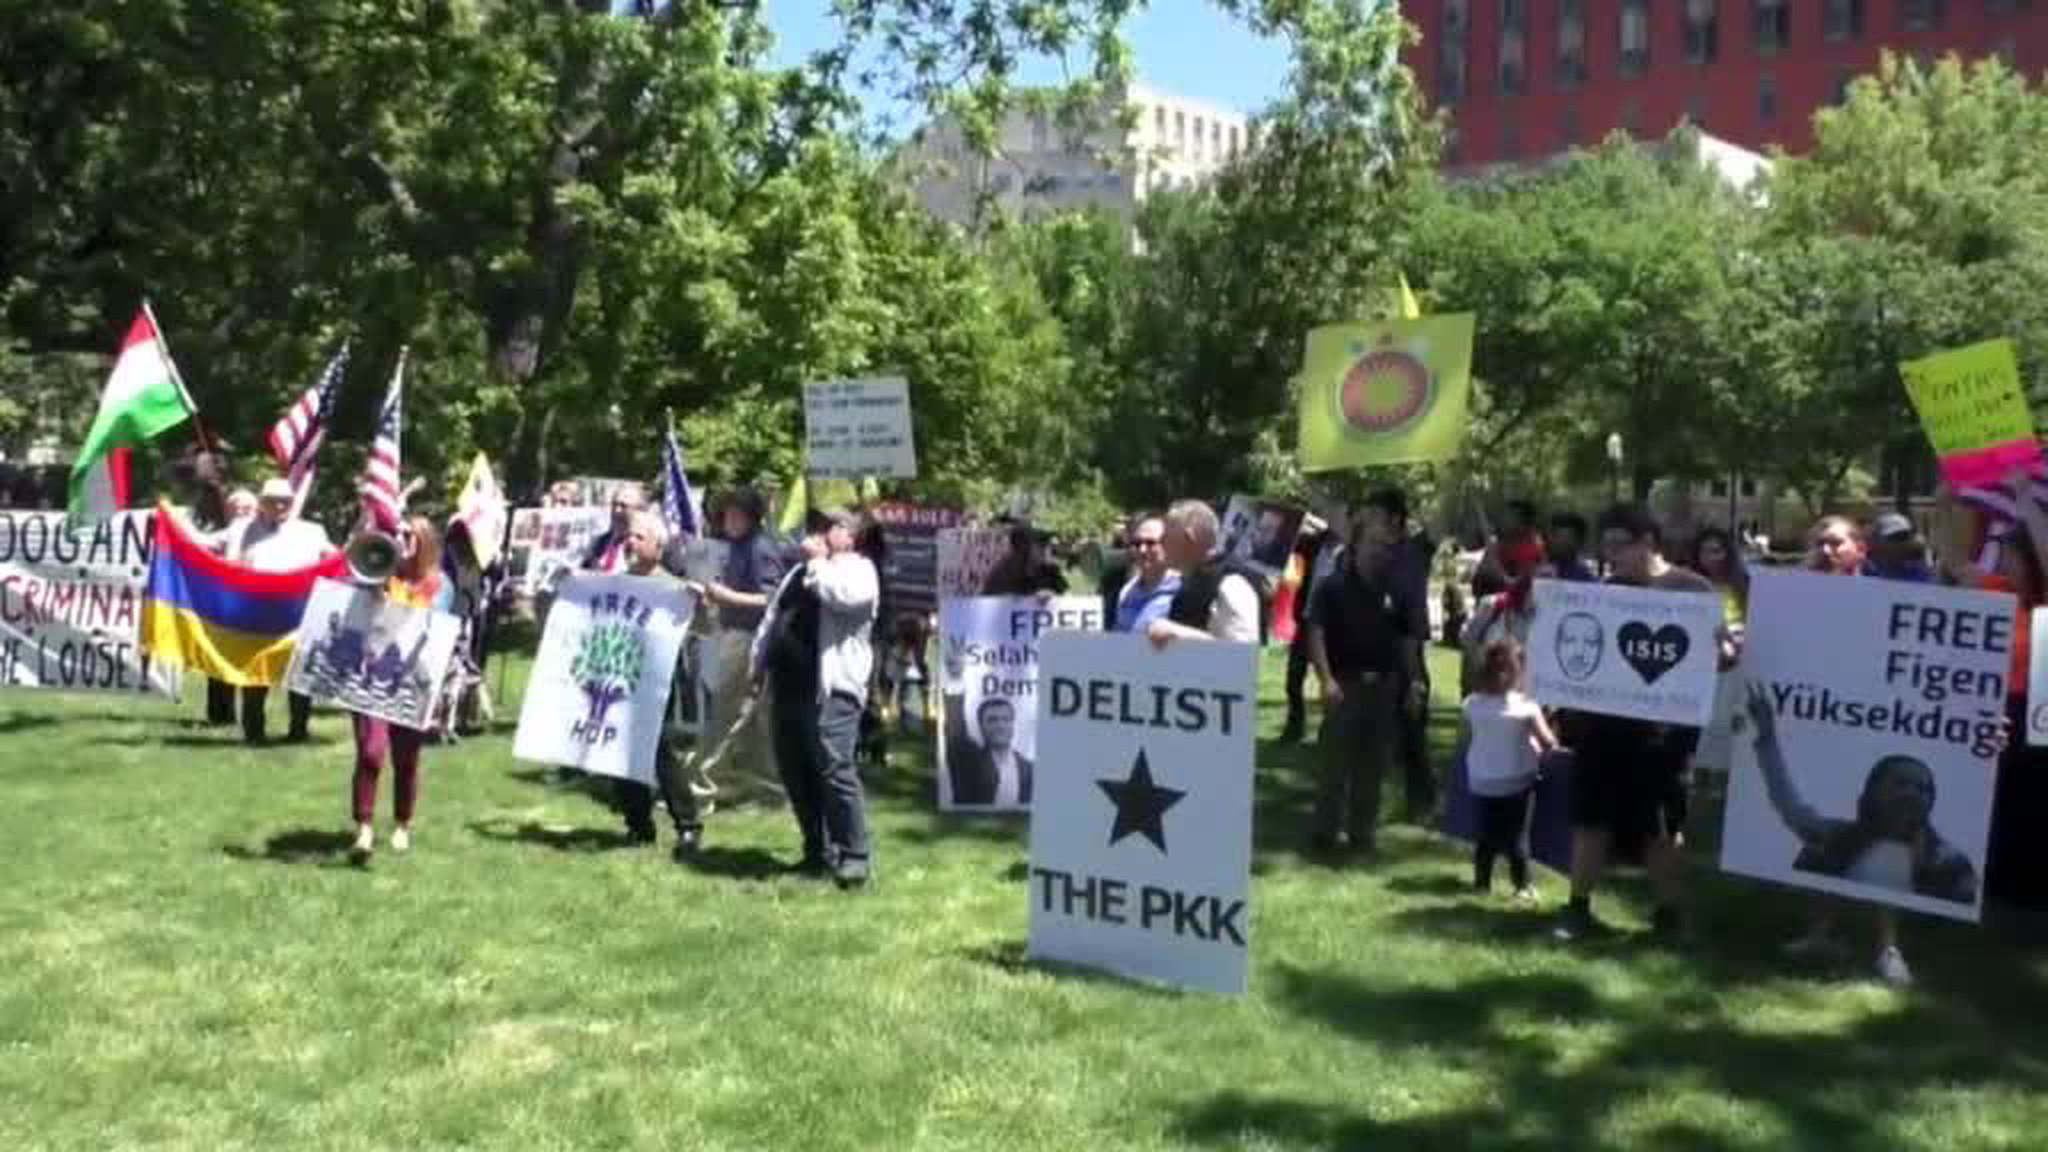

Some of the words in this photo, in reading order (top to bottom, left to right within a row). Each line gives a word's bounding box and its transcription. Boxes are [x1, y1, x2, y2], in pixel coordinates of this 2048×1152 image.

[1, 574, 148, 628] CRIMINA
[590, 593, 652, 627] FREE
[1626, 639, 1679, 663] ISIS
[1889, 603, 2010, 654] FREE
[1886, 650, 2003, 701] Figen
[1050, 677, 1244, 736] DELIST
[1772, 682, 2003, 759] Yüksekdağ
[1033, 867, 1128, 925] THE
[1140, 885, 1246, 947] PKK
